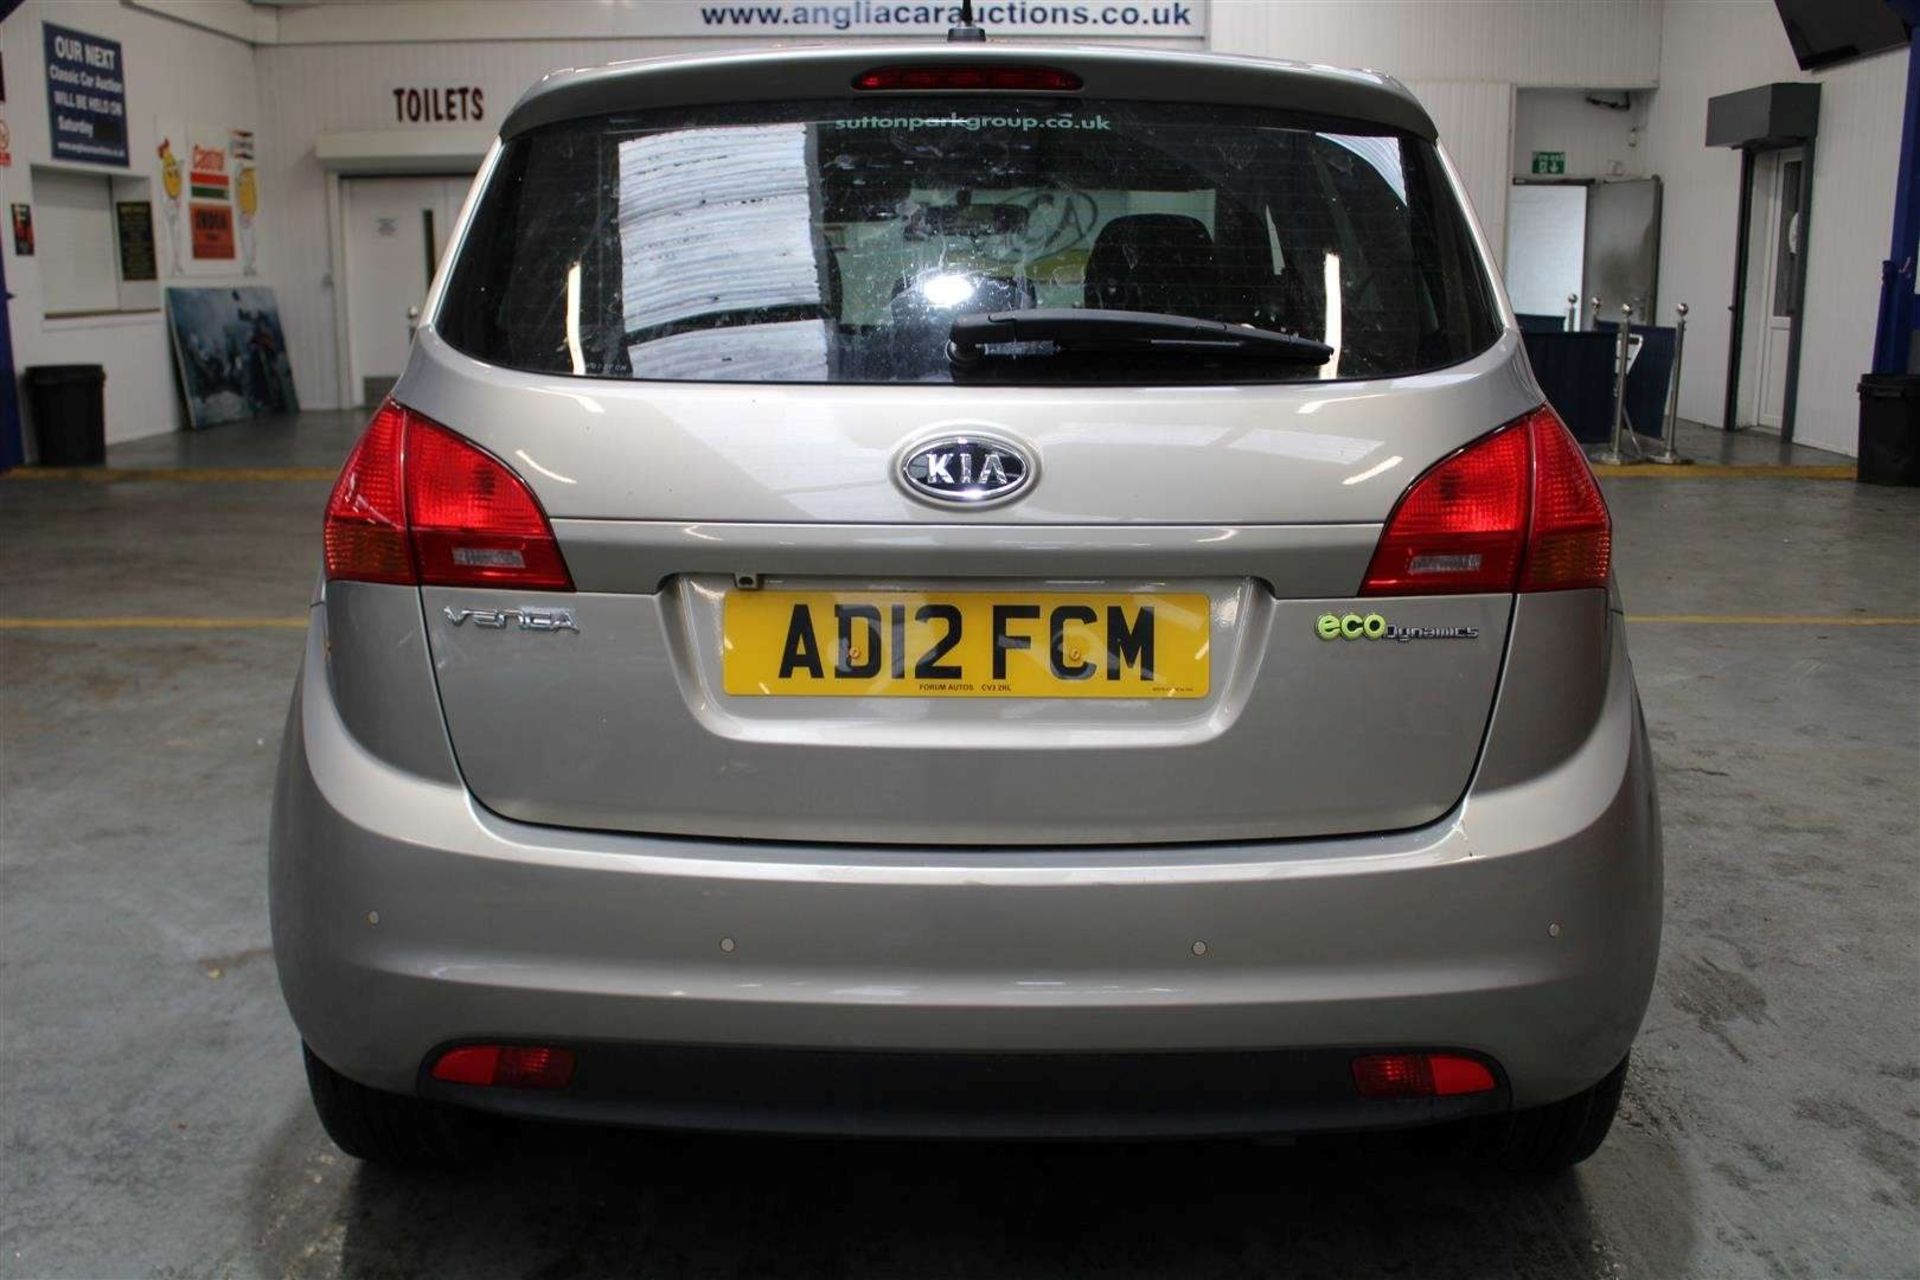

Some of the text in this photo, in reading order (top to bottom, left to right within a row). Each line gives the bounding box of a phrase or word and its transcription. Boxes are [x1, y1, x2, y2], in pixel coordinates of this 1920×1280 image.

[701, 2, 1191, 29] www.angliacarauctions.co.uk
[55, 35, 115, 70] OUR NEXT
[80, 71, 94, 88] Car
[393, 87, 483, 122] TOILETS
[835, 112, 1111, 131] suttonparkgroup.co.uk
[927, 453, 1008, 484] KIA
[779, 603, 1155, 681] AD12 FCM
